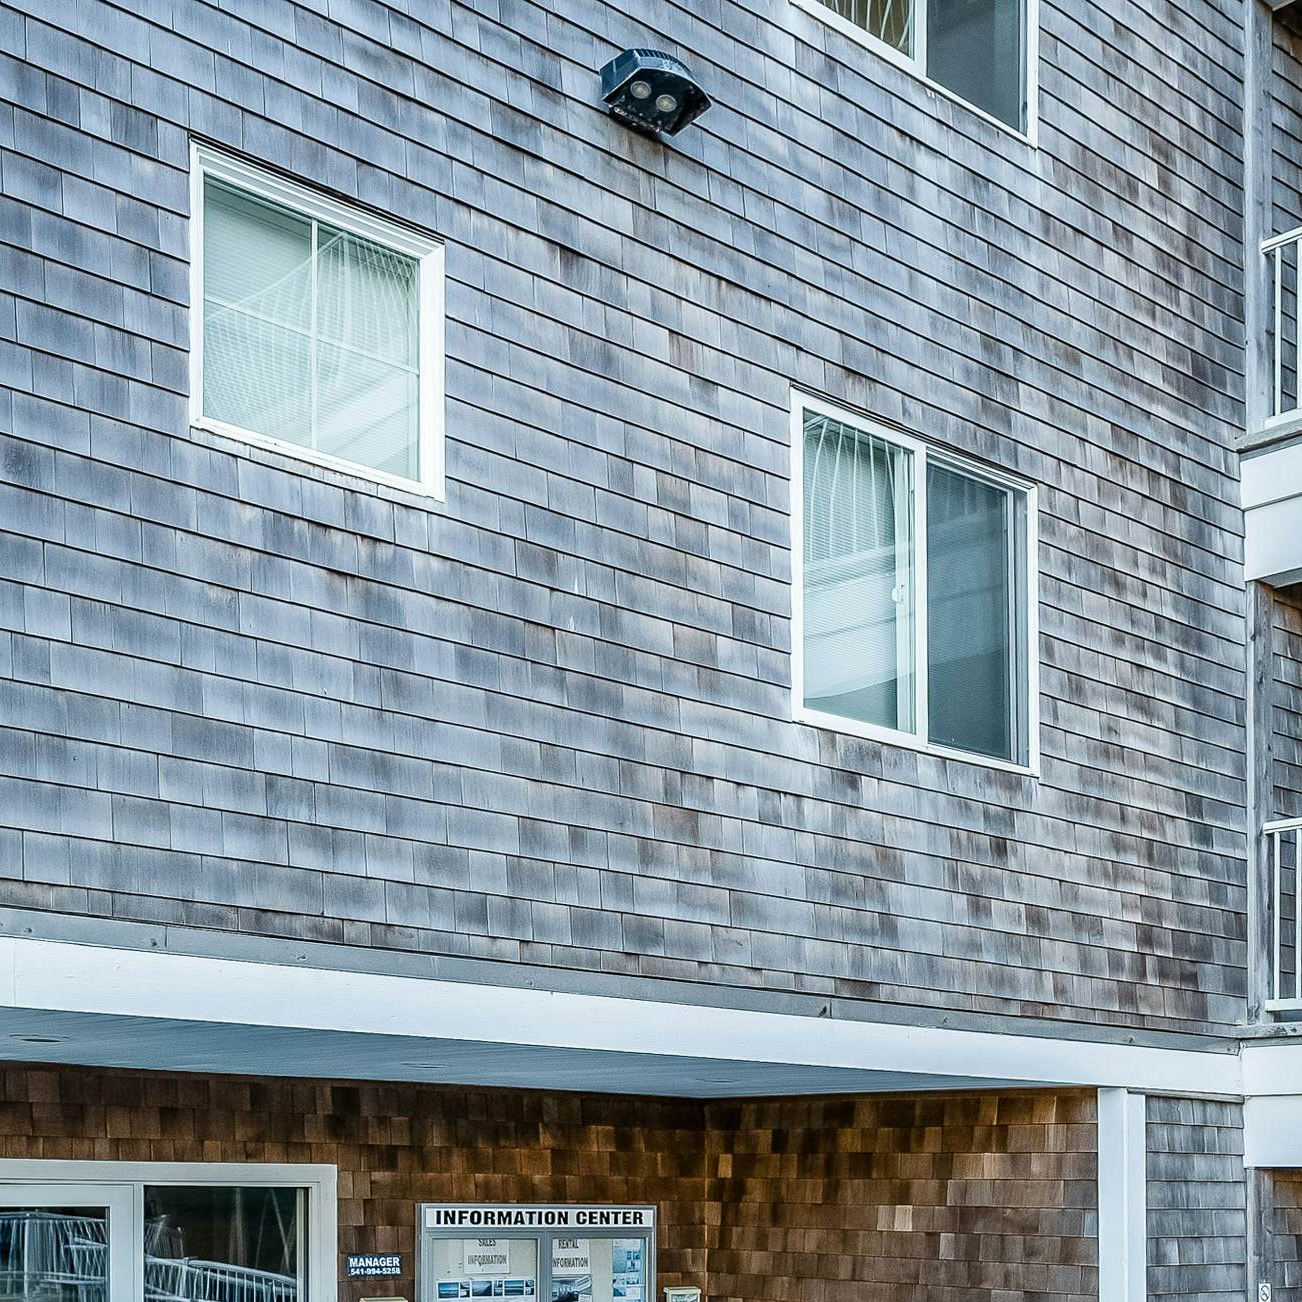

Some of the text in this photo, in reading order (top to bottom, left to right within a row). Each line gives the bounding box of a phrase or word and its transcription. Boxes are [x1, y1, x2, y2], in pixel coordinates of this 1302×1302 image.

[435, 1210, 644, 1225] INFORMATION CENTER
[478, 1239, 497, 1247] SALES
[558, 1239, 579, 1249] RENTAL
[349, 1257, 400, 1268] MANAGER
[467, 1255, 507, 1265] INFORMATION
[552, 1257, 589, 1268] NFORMATION
